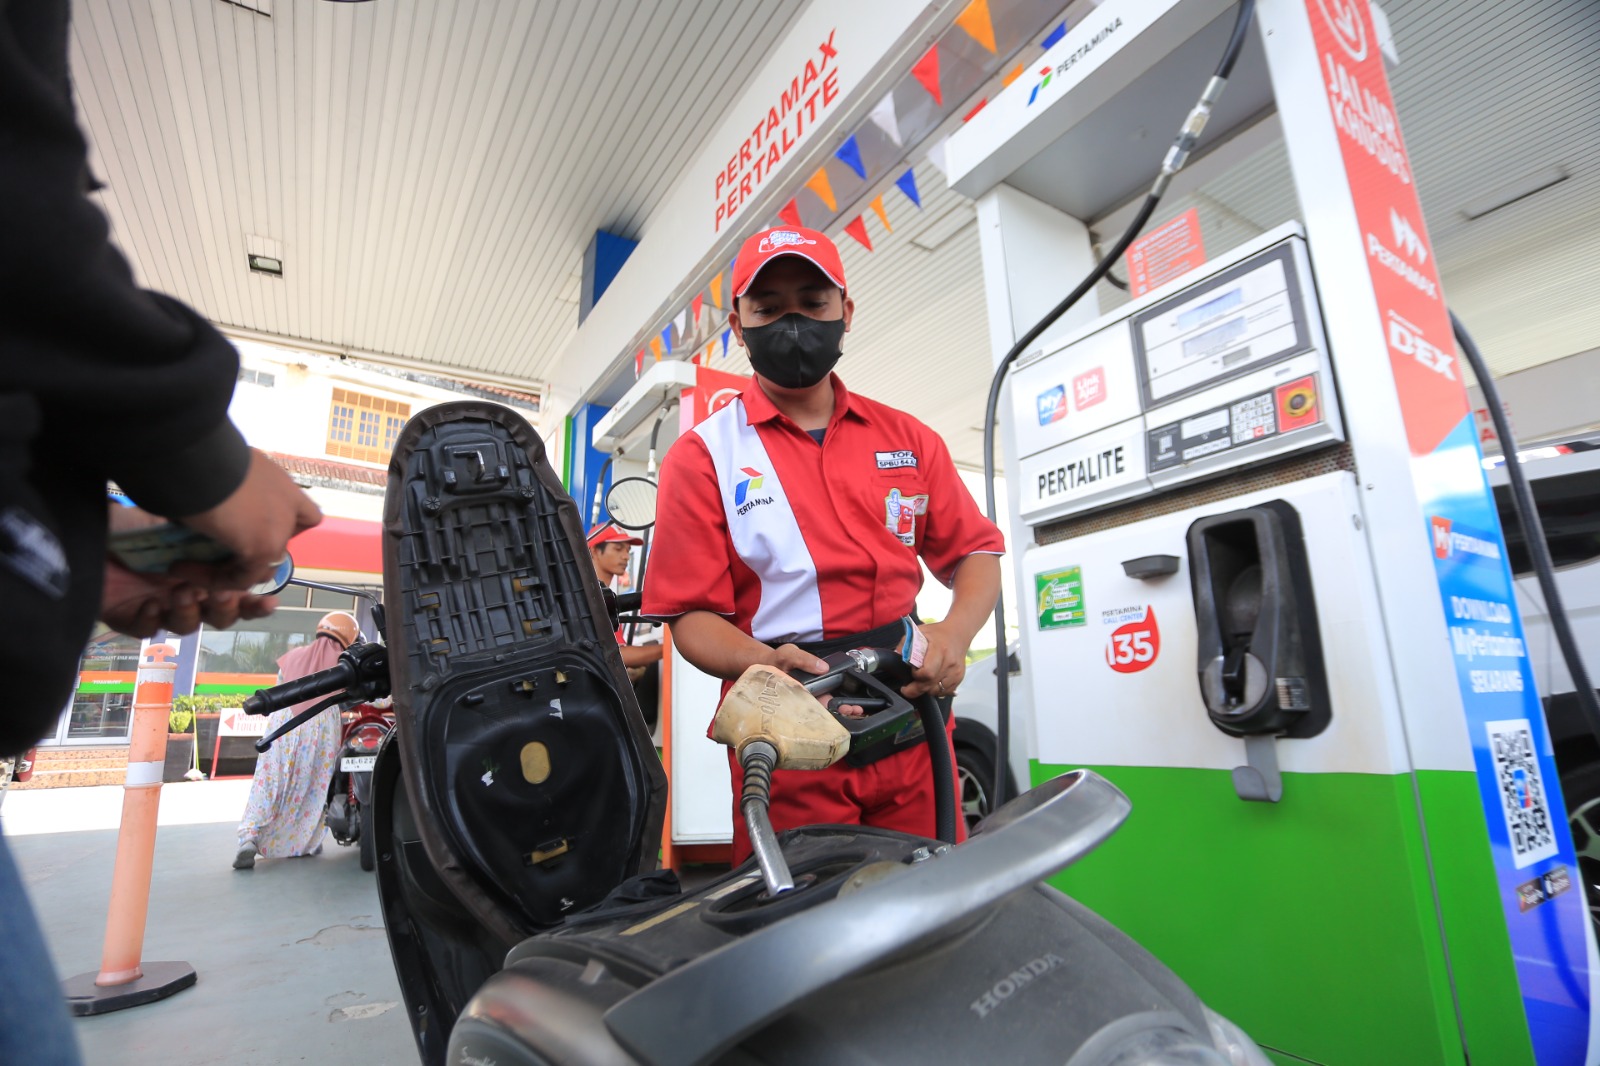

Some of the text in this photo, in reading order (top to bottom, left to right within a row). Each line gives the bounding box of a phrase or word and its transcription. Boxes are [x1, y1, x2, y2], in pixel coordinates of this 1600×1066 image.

[1056, 16, 1123, 77] PERTAMINA
[715, 27, 838, 200] PERTAMAX
[1325, 52, 1401, 151] JALUR
[715, 66, 840, 233] PERTALITE
[1331, 93, 1410, 184] KHUSUS
[1388, 319, 1456, 381] DEX
[1038, 446, 1125, 499] PERTALITE
[736, 496, 775, 515] PERTAMINA
[1451, 596, 1512, 624] DOWNLOAD
[1107, 630, 1154, 666] 135
[1470, 670, 1524, 693] SEKARANG
[970, 952, 1064, 1019] HONDA
